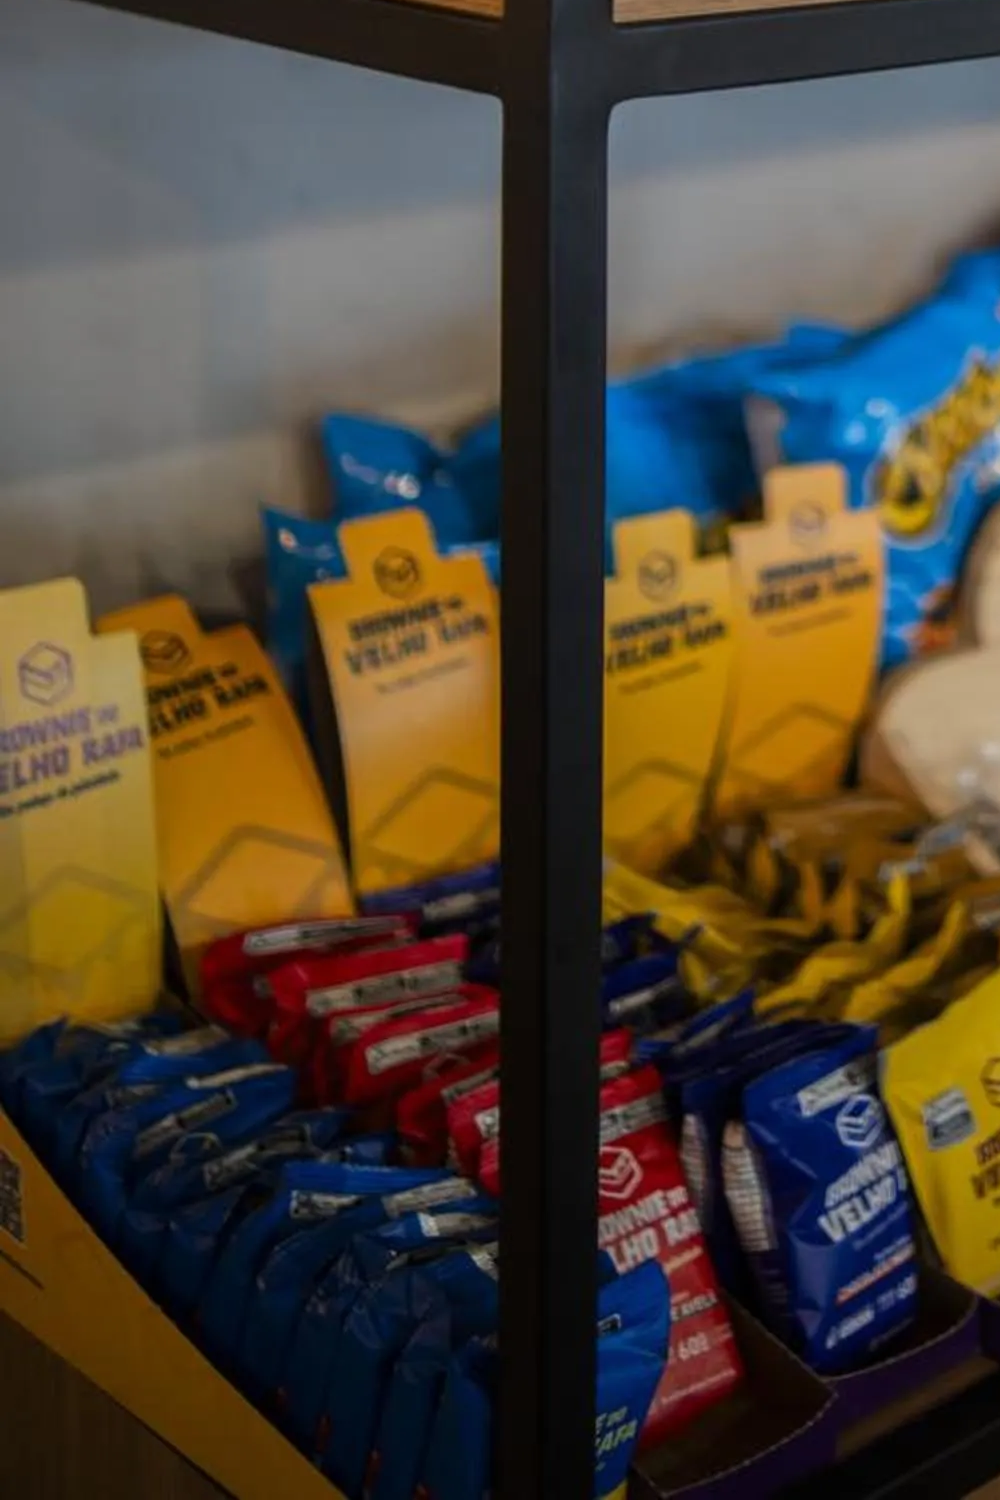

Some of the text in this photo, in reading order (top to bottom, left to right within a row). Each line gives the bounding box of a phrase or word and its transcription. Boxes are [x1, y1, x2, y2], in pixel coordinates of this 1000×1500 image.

[0, 706, 91, 753] ROWNIE
[0, 744, 70, 795] ELHO
[598, 1189, 669, 1251] OWNIE
[817, 1175, 896, 1242] VELHO
[608, 1227, 660, 1273] LHO
